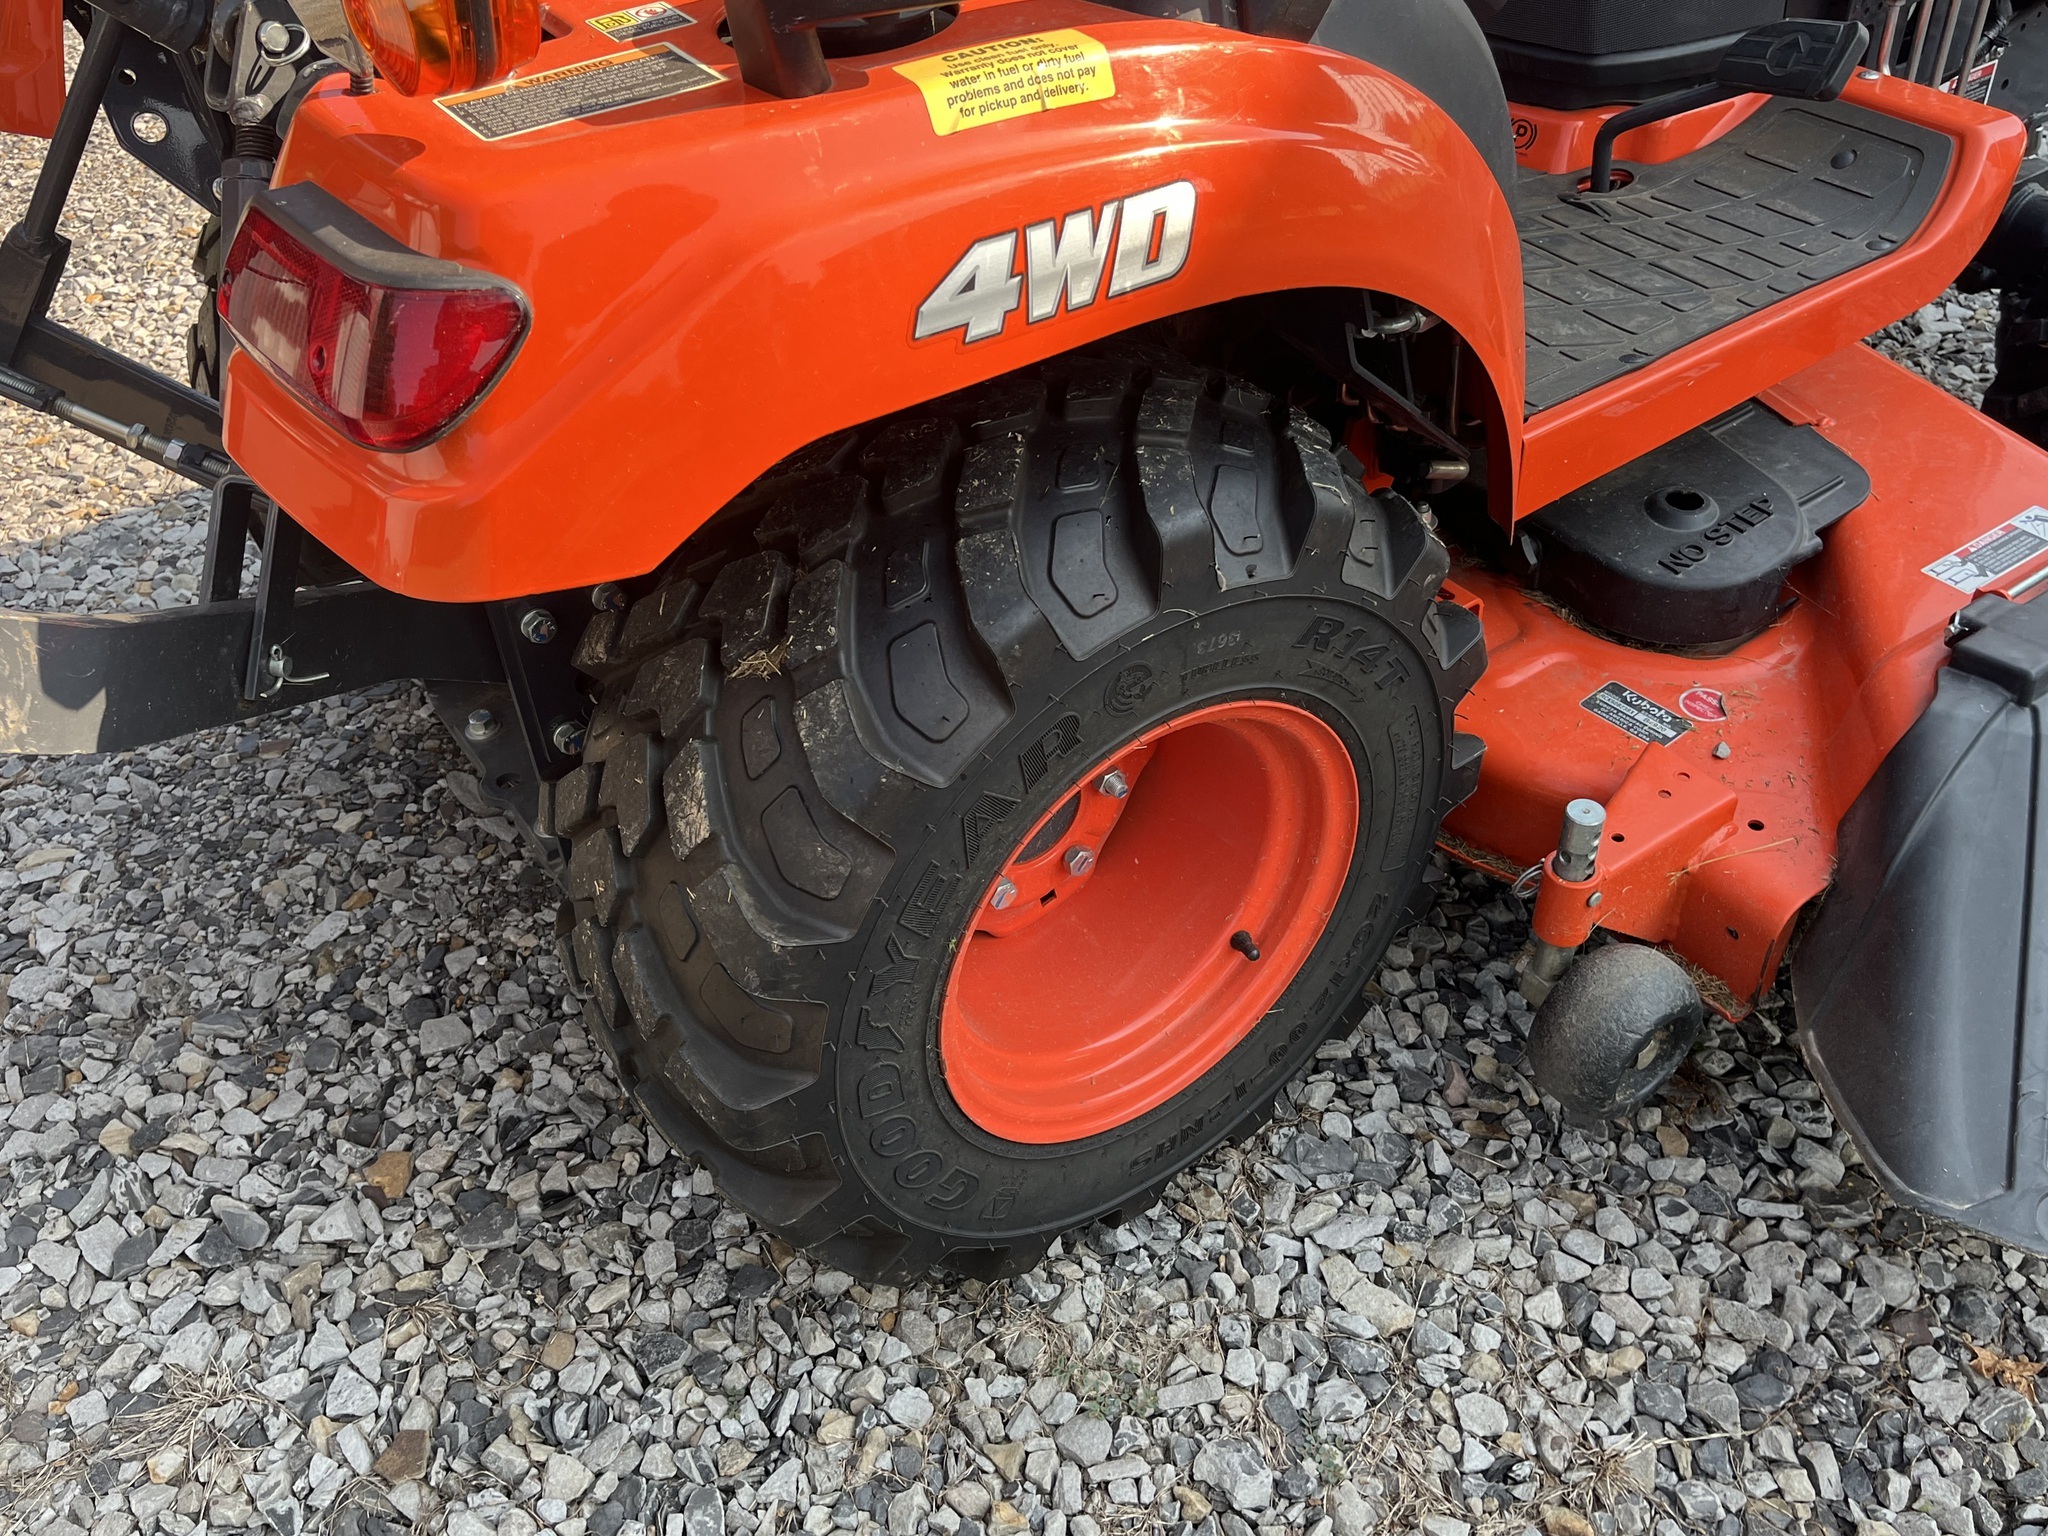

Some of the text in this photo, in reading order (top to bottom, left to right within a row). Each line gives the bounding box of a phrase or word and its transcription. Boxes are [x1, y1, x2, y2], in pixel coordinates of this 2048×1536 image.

[940, 37, 1044, 63] CAUTION:
[940, 43, 1079, 78] Warranty does not cover
[947, 58, 970, 69] Use
[971, 53, 1001, 66] clean
[1003, 48, 1028, 60] fuel
[521, 59, 615, 85] WARNING
[946, 64, 1097, 109] problems and does not pay
[949, 50, 1086, 90] water in fuel or dirty fuel
[959, 82, 1090, 120] for pickup and delivery.
[913, 178, 1198, 346] 4WD
[1657, 498, 1775, 576] NO STEP
[1622, 690, 1673, 723] Kubota
